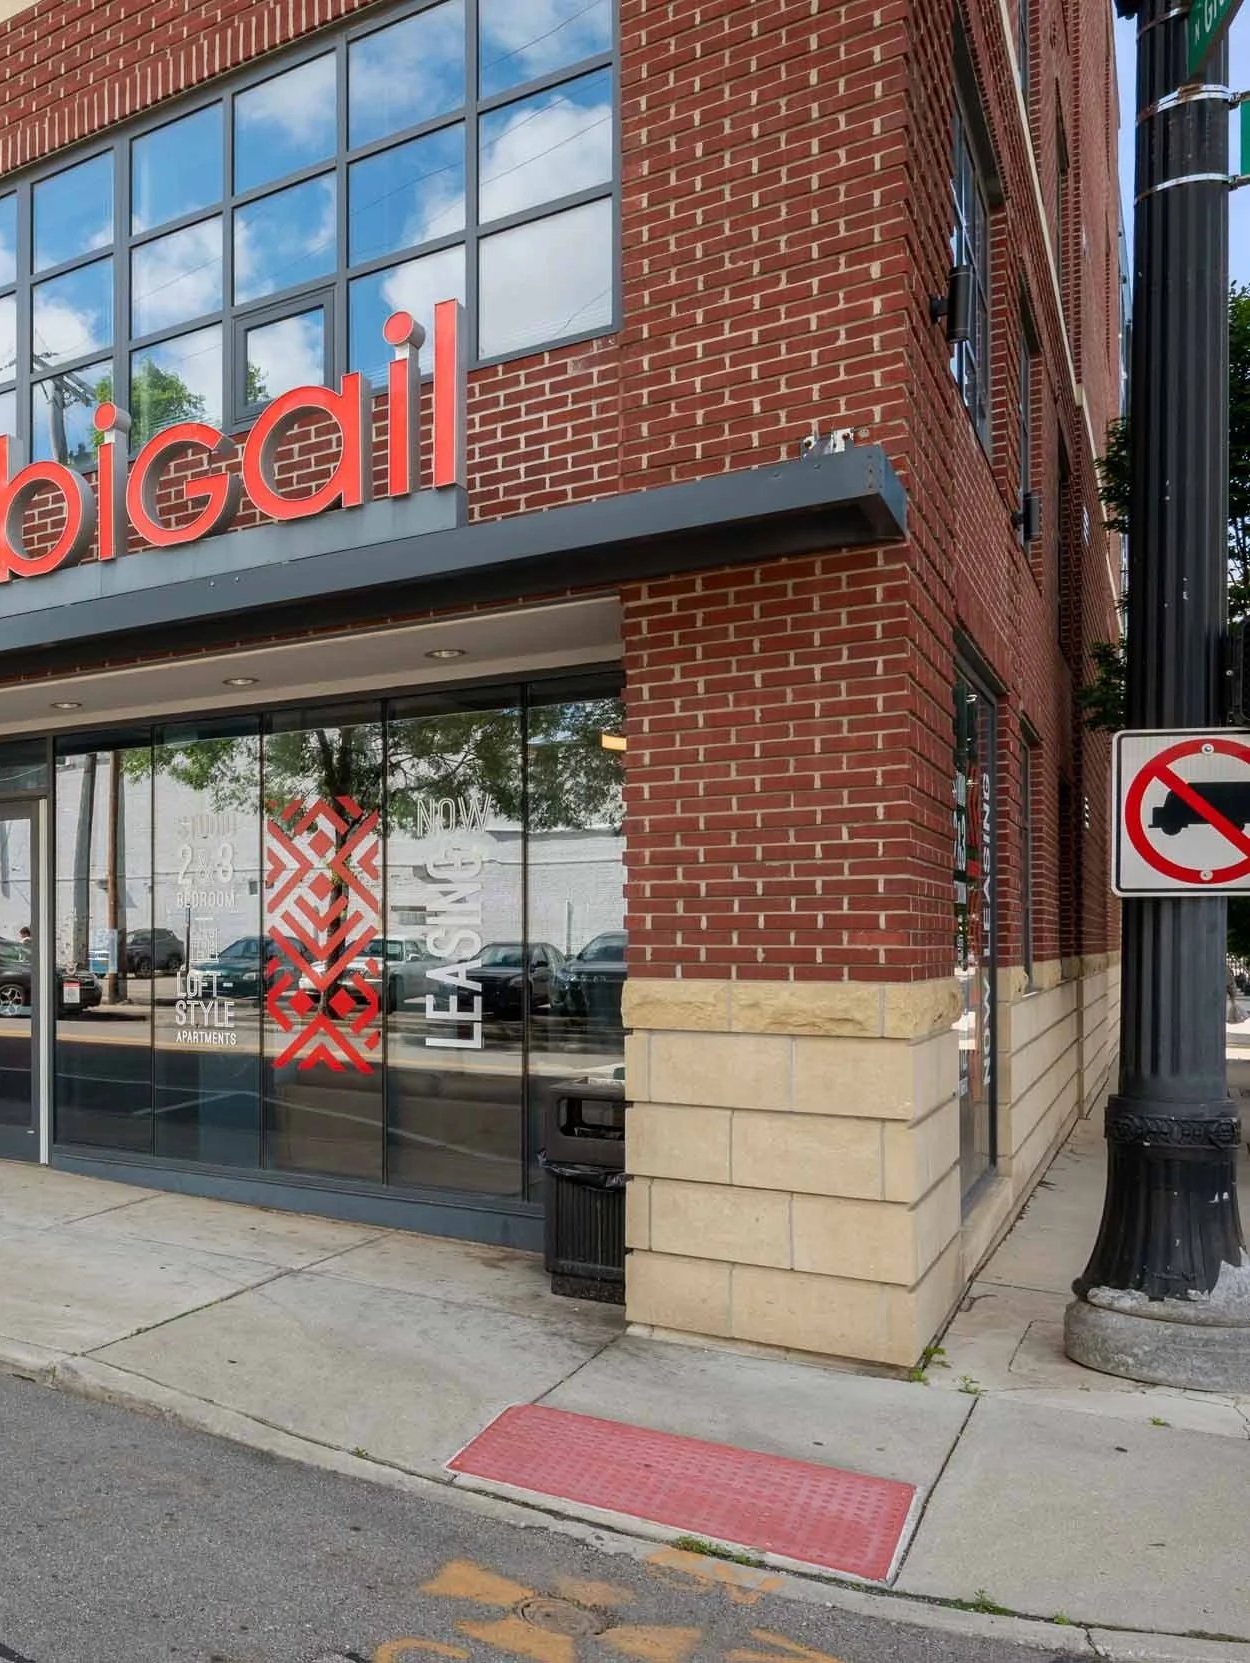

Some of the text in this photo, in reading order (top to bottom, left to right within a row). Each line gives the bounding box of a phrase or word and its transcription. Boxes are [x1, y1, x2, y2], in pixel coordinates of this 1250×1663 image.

[417, 793, 492, 837] NOW
[178, 844, 193, 885] 2
[220, 843, 234, 882] 3
[982, 773, 990, 956] LEASING
[177, 888, 236, 908] BEDROOM
[425, 845, 482, 1049] LEASING
[176, 971, 222, 998] LOFT
[175, 1001, 235, 1028] STYLE
[176, 1031, 237, 1046] APARTMENTS
